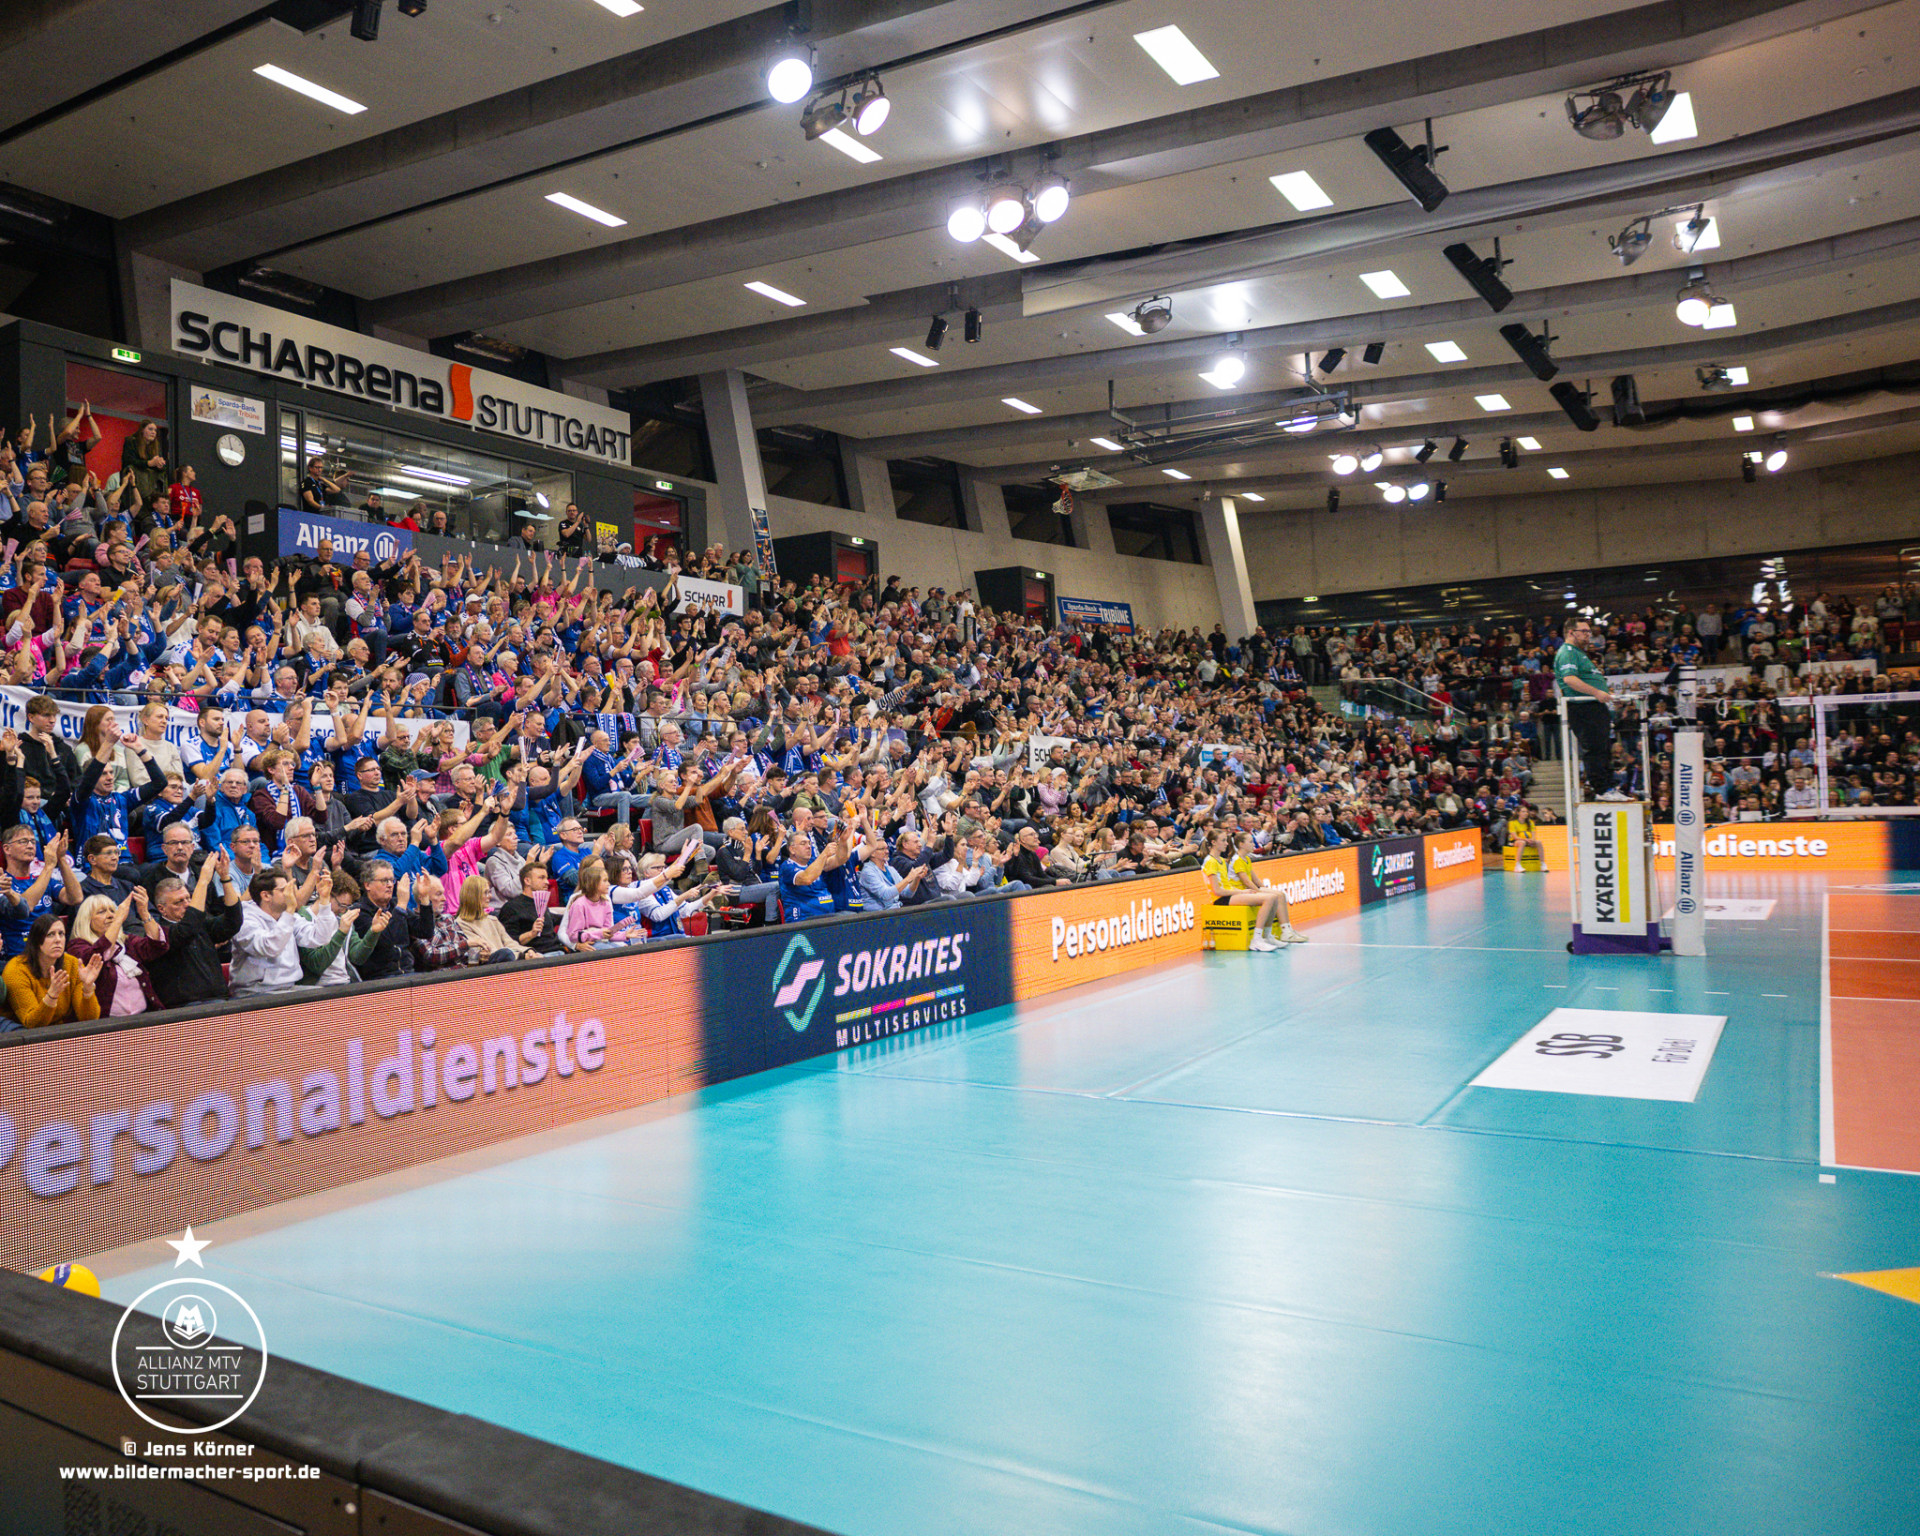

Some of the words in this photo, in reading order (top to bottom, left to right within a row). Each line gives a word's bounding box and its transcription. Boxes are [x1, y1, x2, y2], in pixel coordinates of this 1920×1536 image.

[178, 310, 444, 414] SCHARRena
[477, 394, 631, 460] STUTTGART
[218, 398, 256, 412] Sparda-Bank
[296, 523, 369, 554] Allianz
[684, 590, 726, 607] SCHARR
[1680, 763, 1693, 807] Allianz
[1383, 851, 1415, 875] SOKRATES
[1594, 812, 1615, 923] KÄRCHER
[1680, 851, 1694, 895] Allianz
[1263, 867, 1345, 905] sonaldienste
[1051, 896, 1194, 961] Personaldienste
[833, 933, 963, 997] SOKRATES
[836, 998, 966, 1047] MULTISERVICES
[1535, 1033, 1625, 1059] SSB
